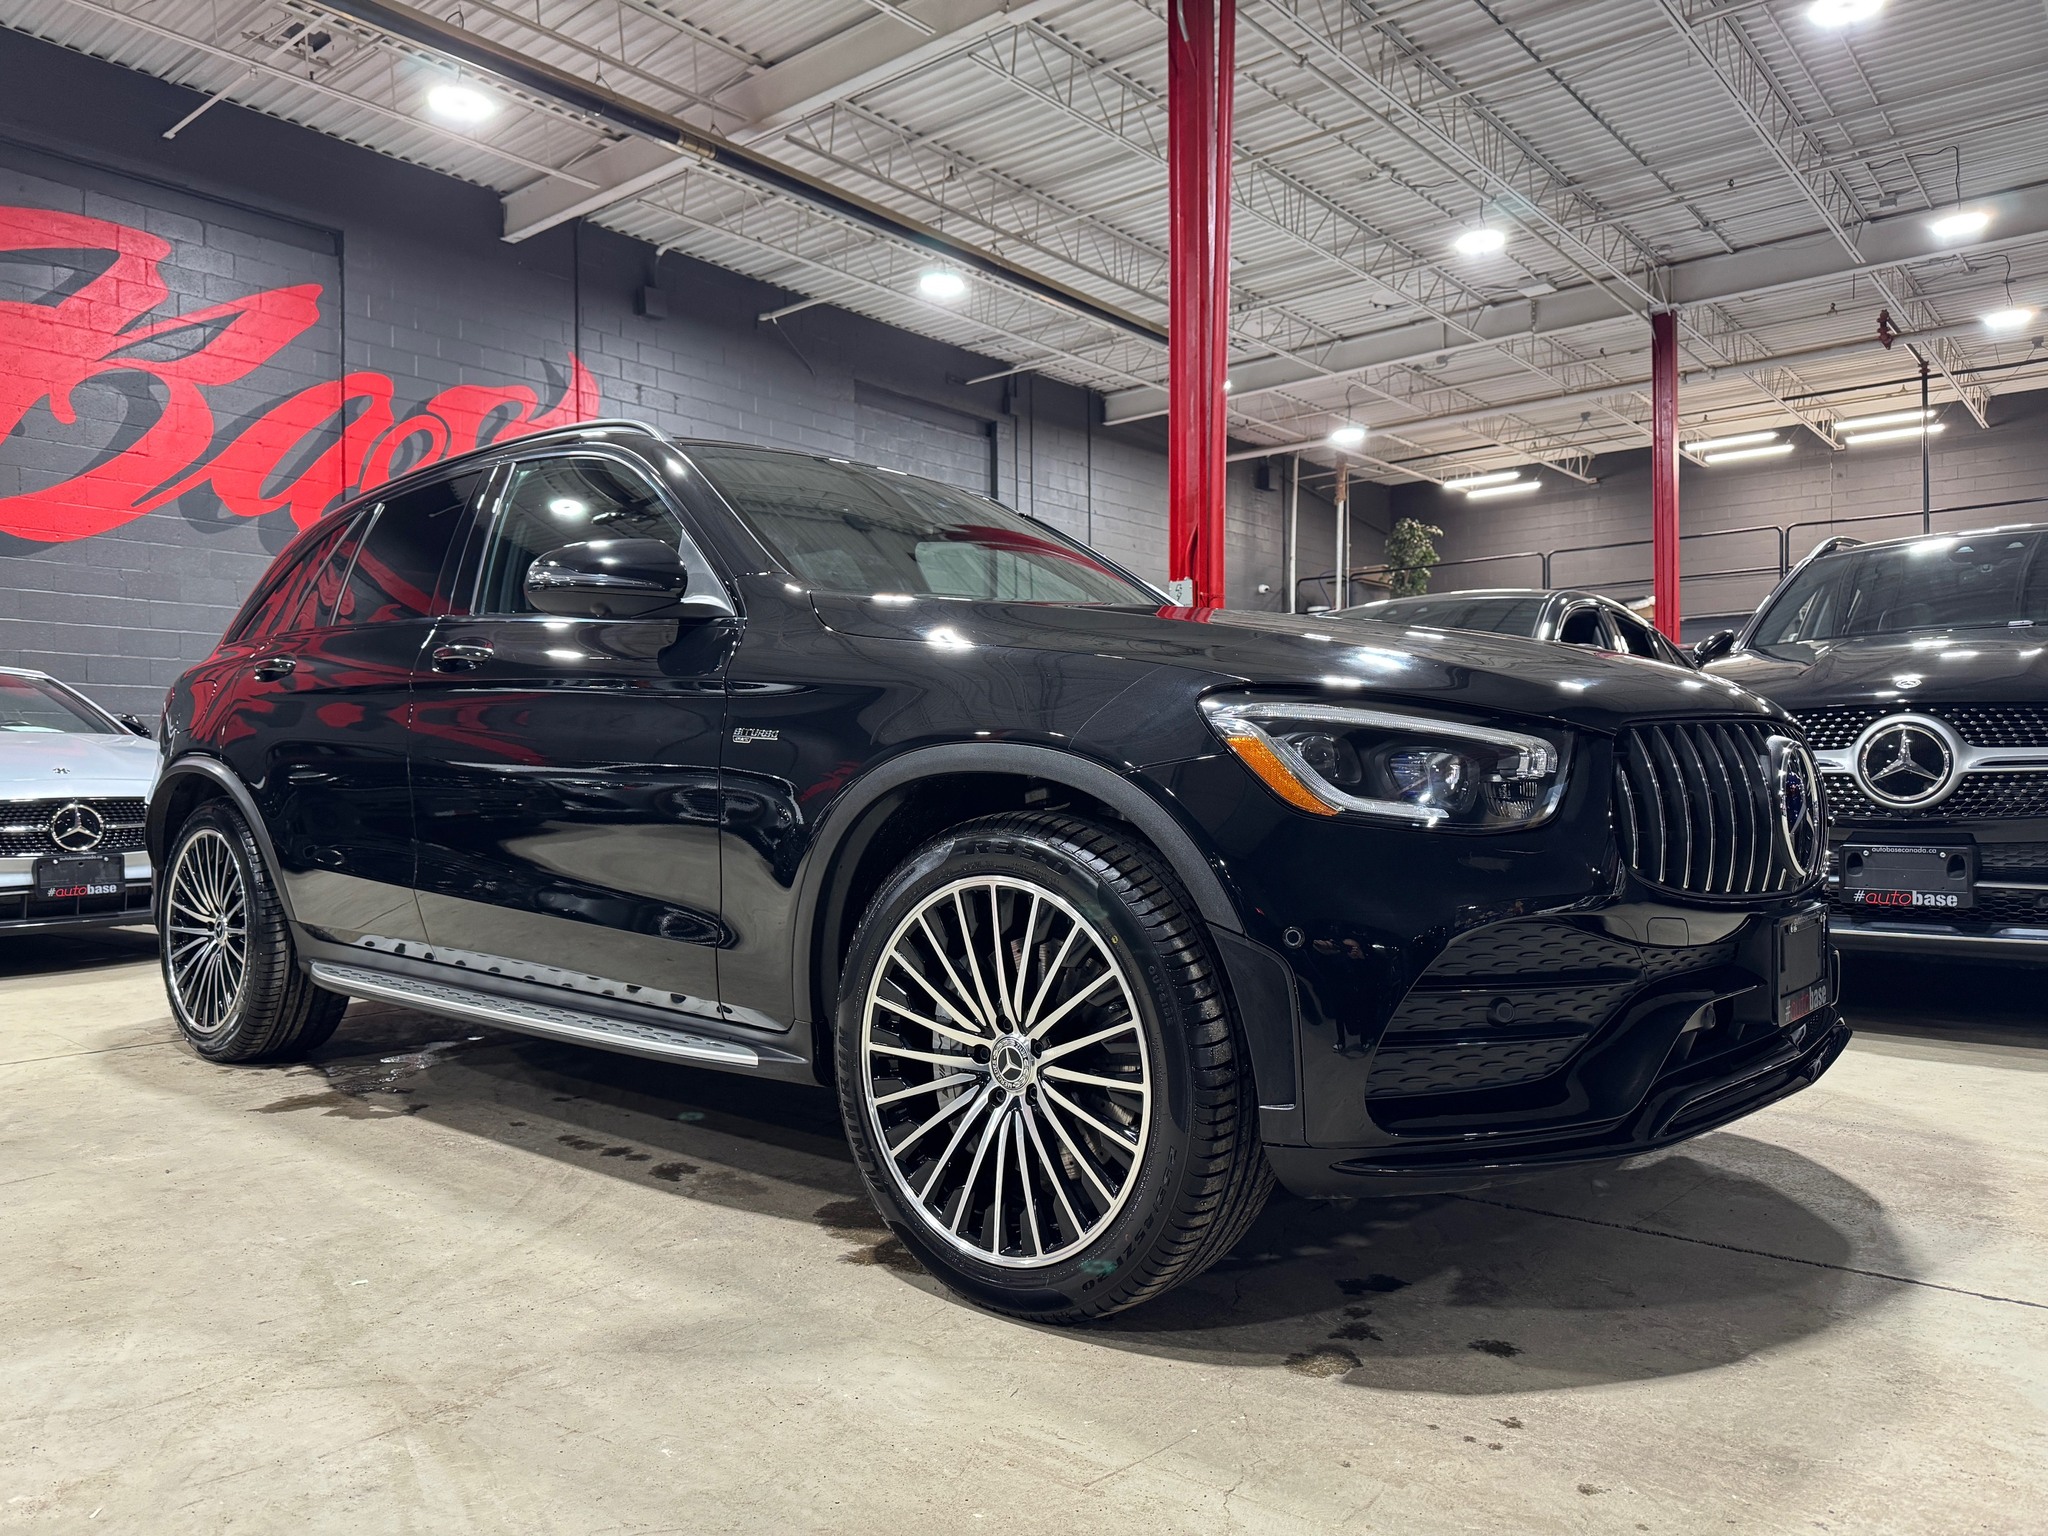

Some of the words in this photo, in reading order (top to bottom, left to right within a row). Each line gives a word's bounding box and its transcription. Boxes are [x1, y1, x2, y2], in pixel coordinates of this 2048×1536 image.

[733, 727, 780, 738] BITURBO
[1871, 846, 1937, 854] autobasecanada.ca
[47, 883, 117, 898] #autobase
[1853, 889, 1958, 908] #autobase
